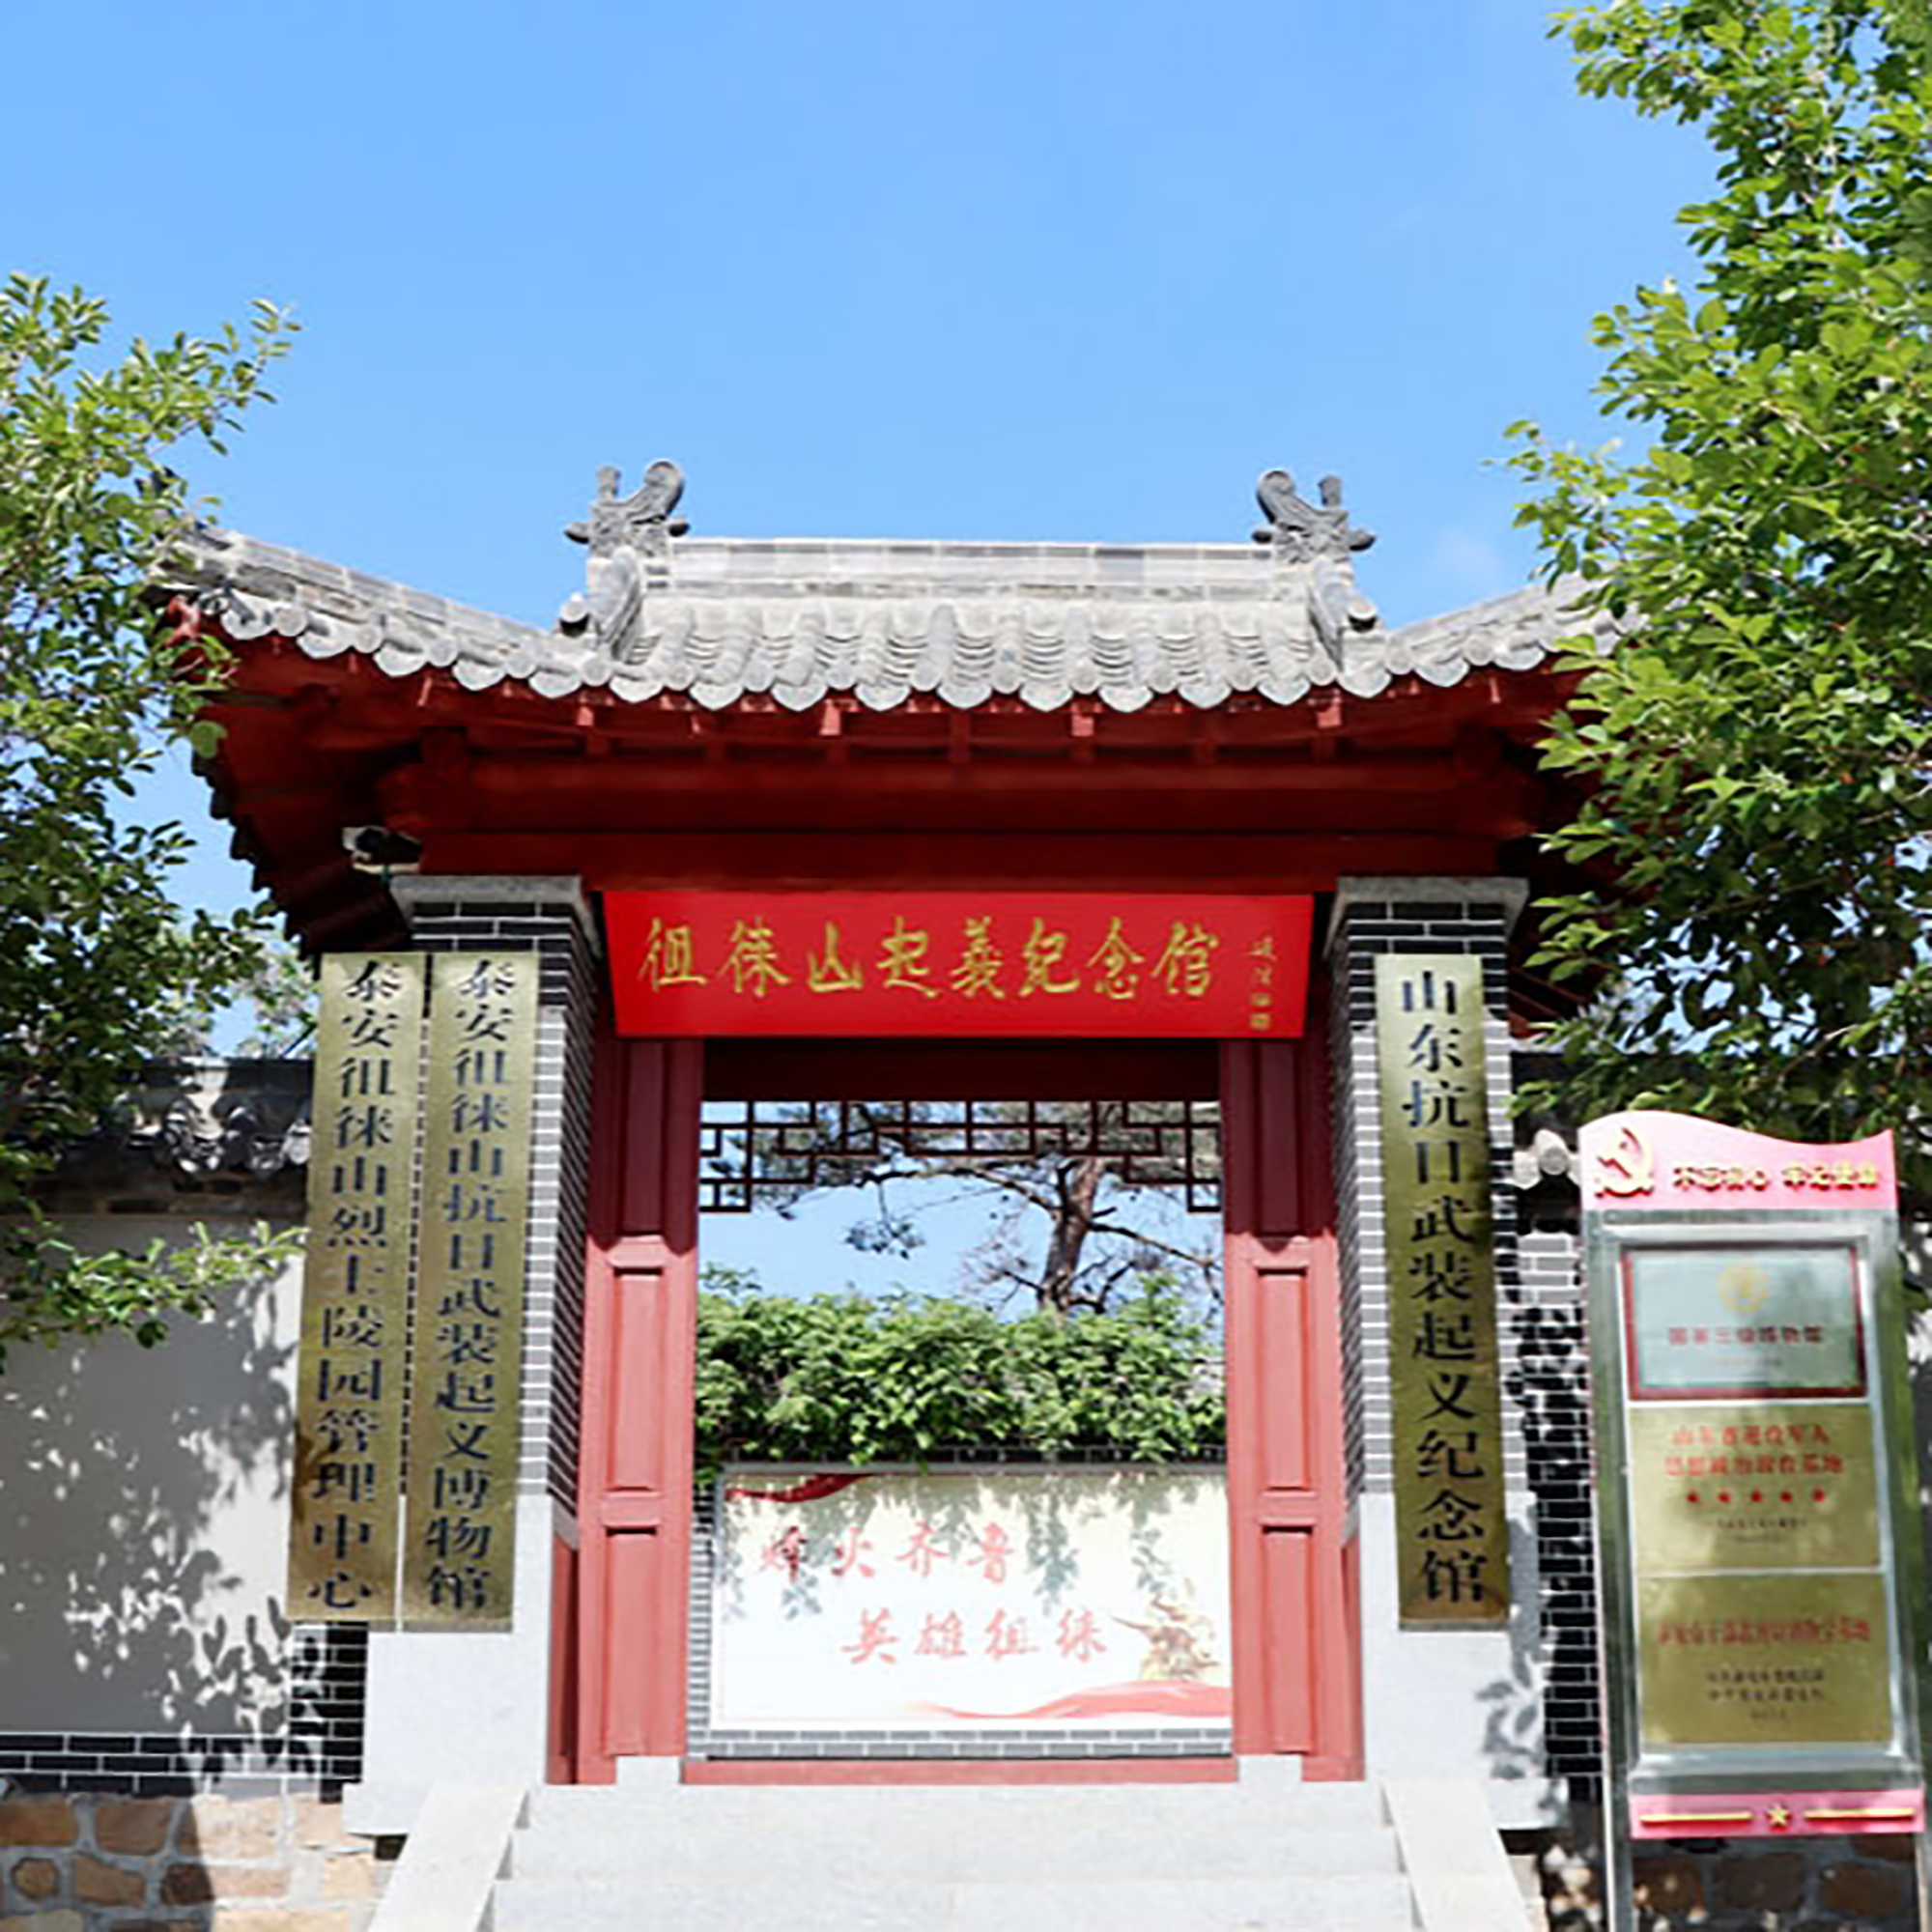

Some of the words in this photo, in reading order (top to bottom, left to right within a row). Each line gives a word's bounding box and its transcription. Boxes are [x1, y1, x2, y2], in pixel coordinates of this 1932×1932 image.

[308, 959, 401, 1609] 泰安徂徕山烈士陵园管理中心
[424, 959, 516, 1610] 泰安徂徕山抗日武装起义博物馆
[1402, 970, 1488, 1604] 山东抗日武装起义纪念馆
